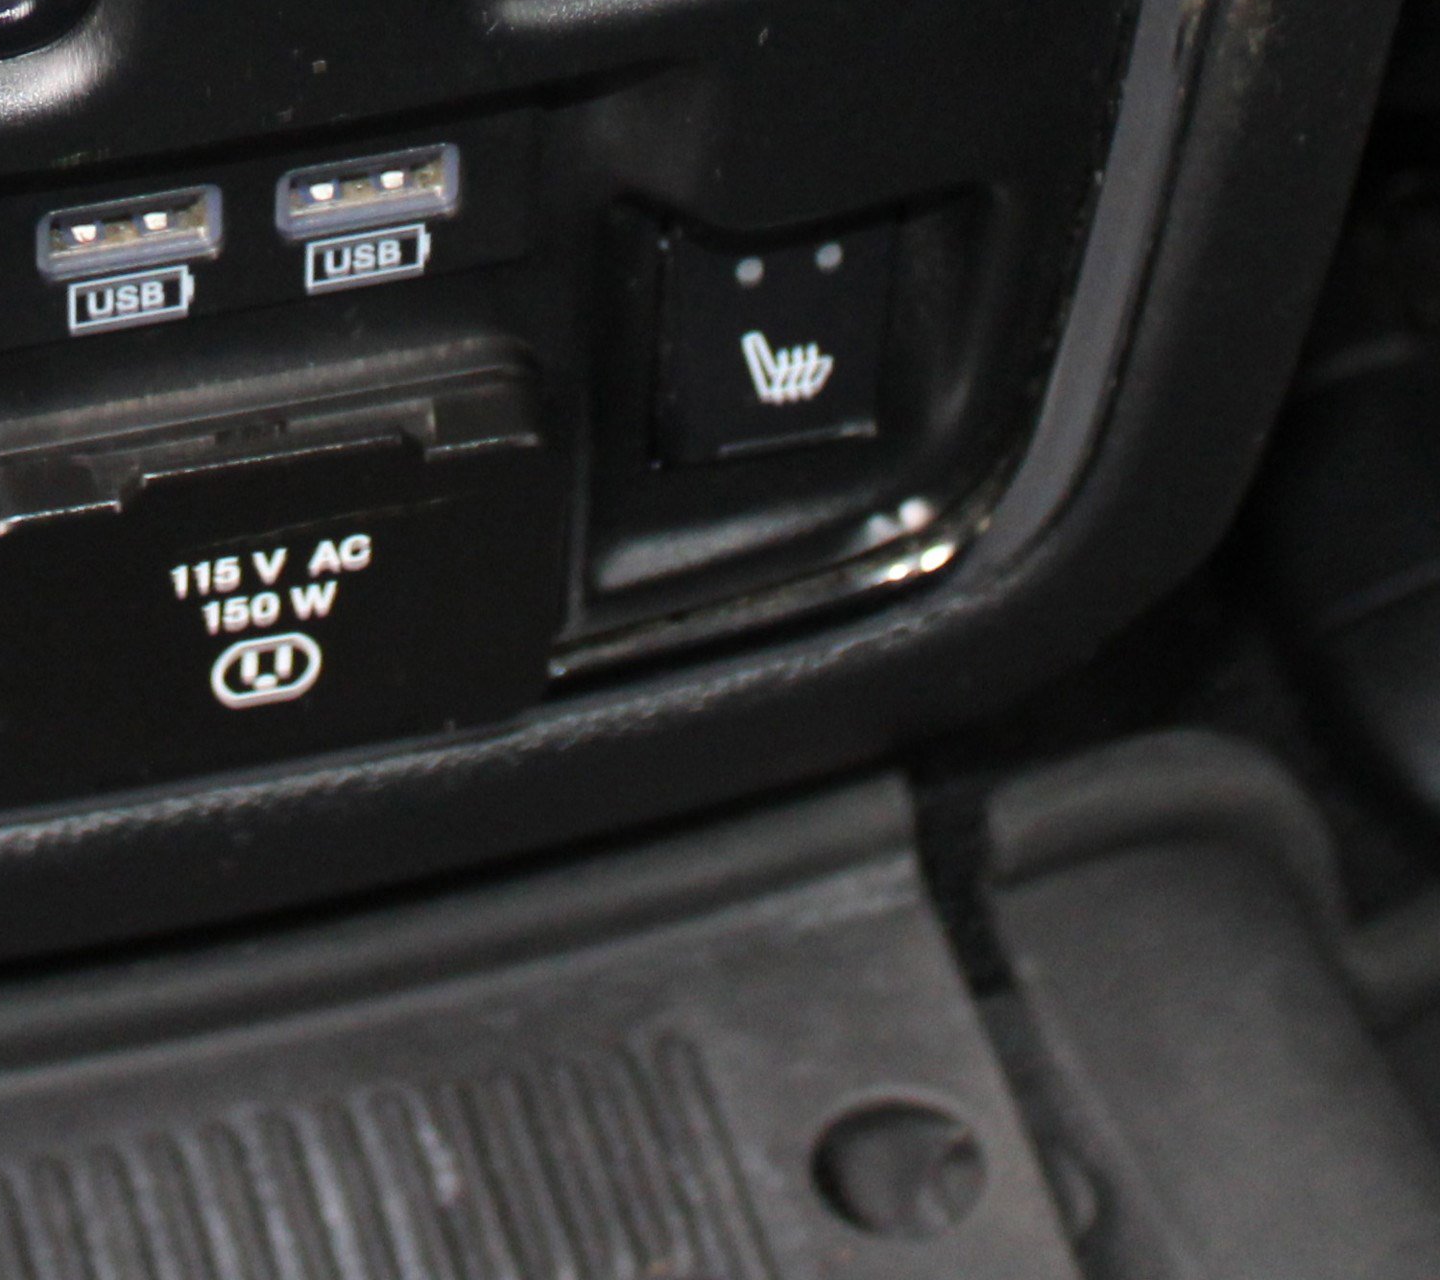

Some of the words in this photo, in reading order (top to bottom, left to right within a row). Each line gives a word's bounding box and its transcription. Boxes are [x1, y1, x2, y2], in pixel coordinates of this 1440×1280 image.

[324, 238, 403, 276] USB
[86, 281, 166, 319] USB
[170, 555, 241, 600] 115
[252, 547, 287, 585] V
[308, 534, 371, 577] AC
[202, 591, 280, 635] 150
[289, 580, 338, 621] W
